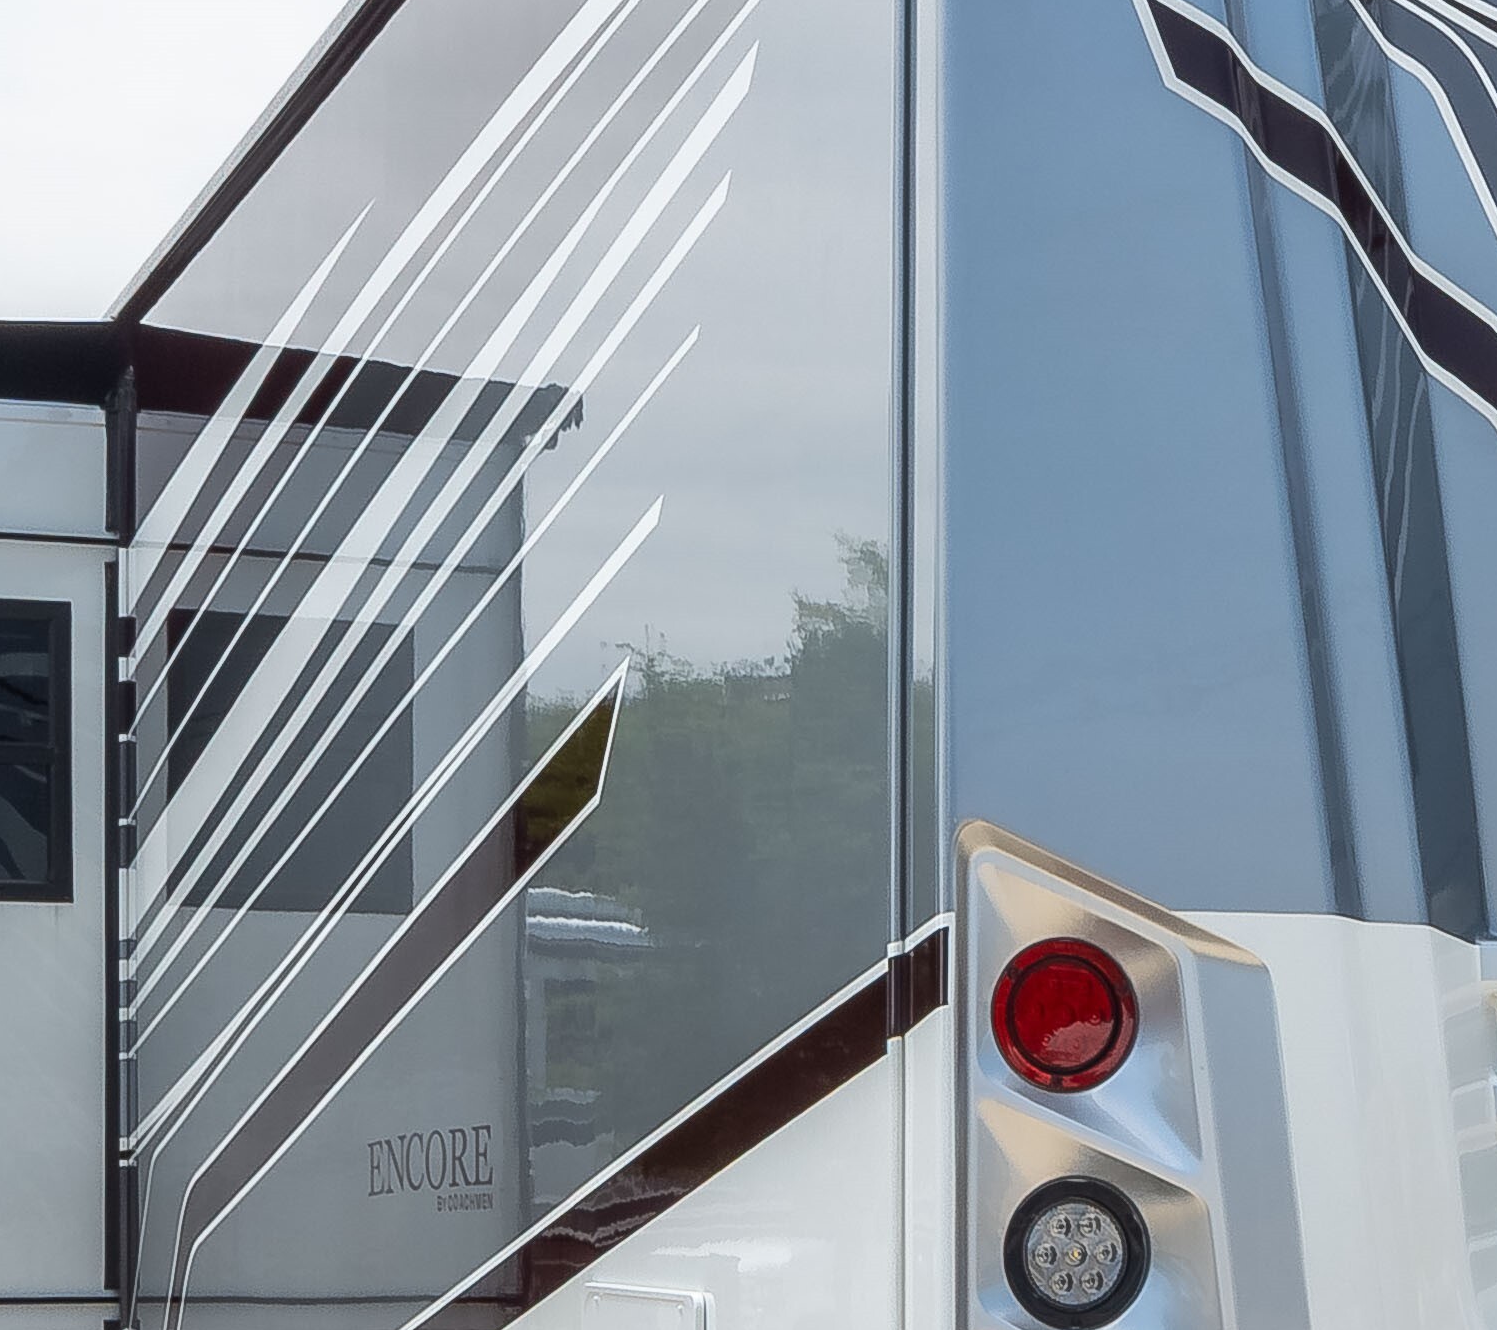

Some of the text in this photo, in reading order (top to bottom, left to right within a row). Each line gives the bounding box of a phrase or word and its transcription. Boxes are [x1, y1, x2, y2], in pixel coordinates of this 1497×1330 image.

[367, 1124, 494, 1198] ENCORE
[437, 1193, 493, 1212] BY COACHMEN
